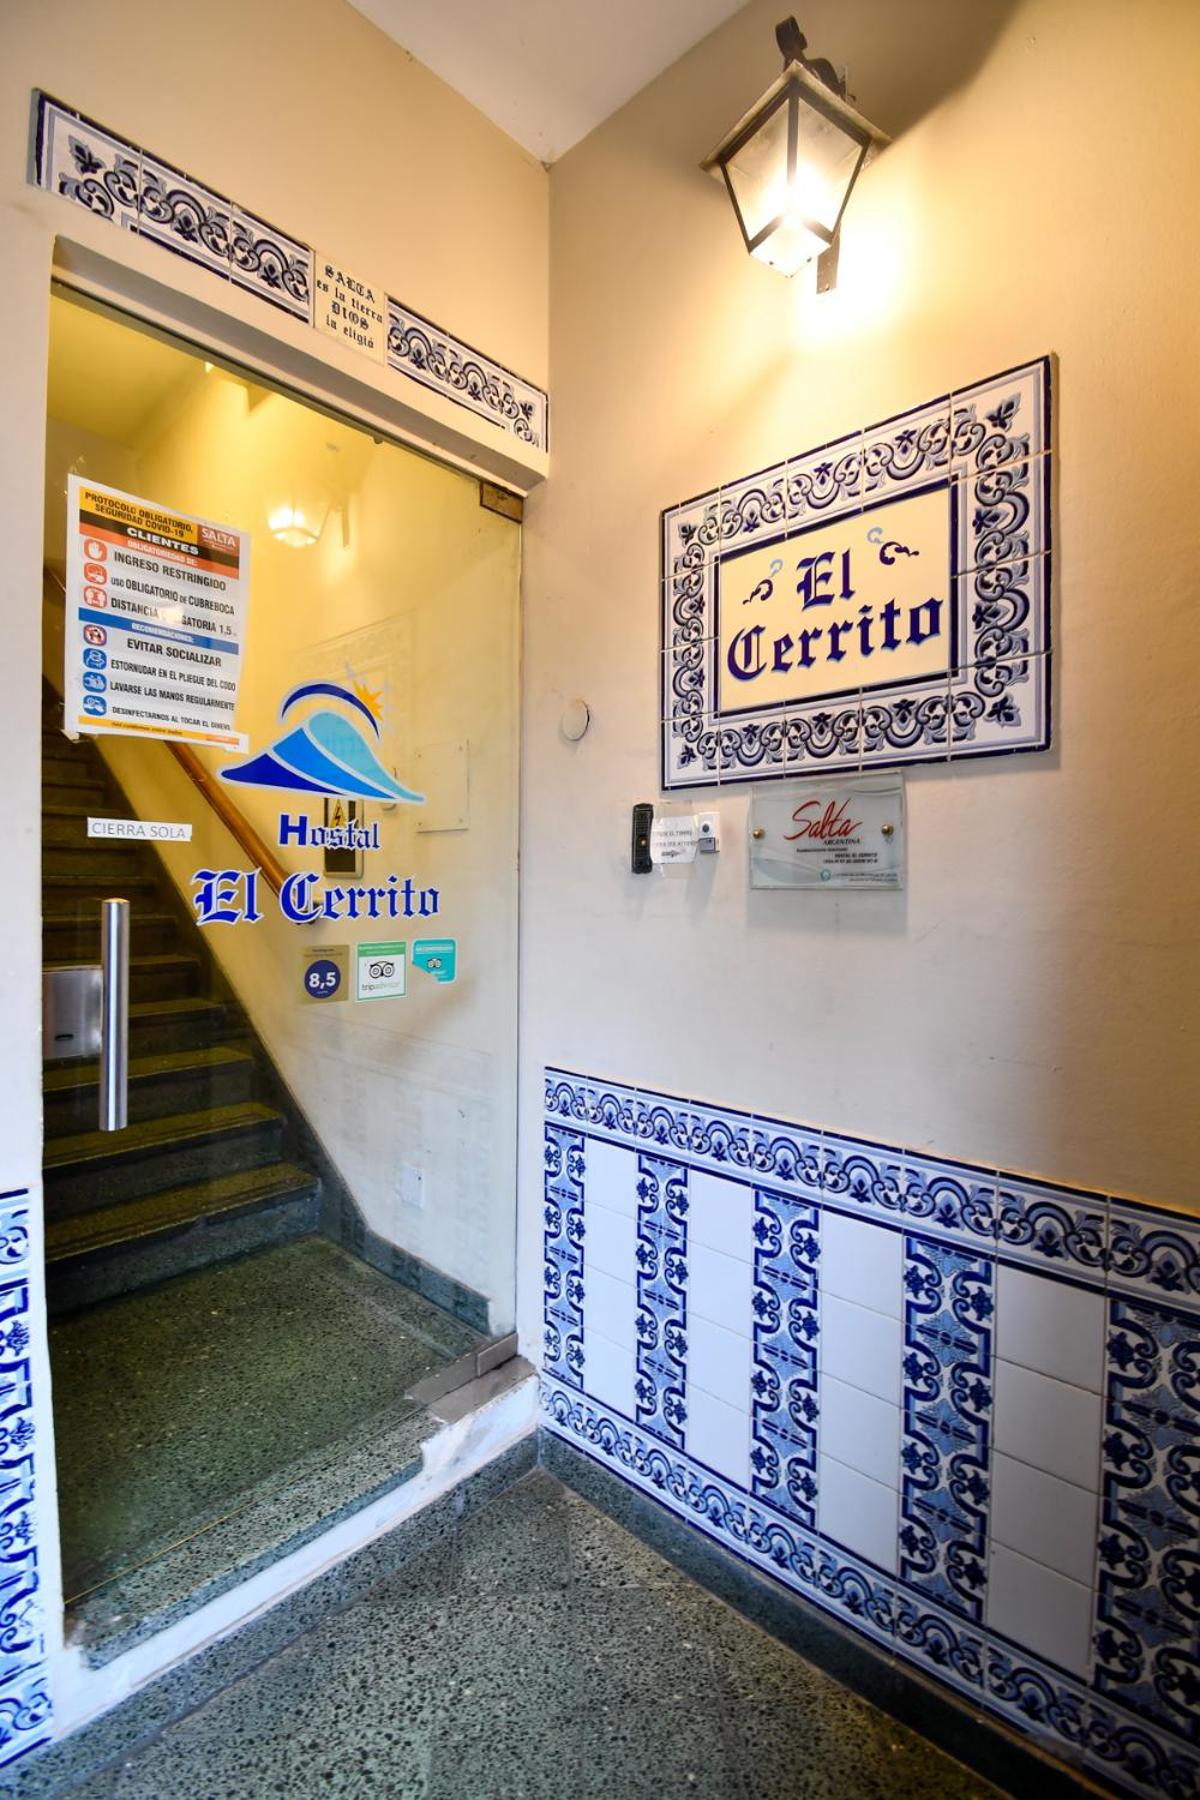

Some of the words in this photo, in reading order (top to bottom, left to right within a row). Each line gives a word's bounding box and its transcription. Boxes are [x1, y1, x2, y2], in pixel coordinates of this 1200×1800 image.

[95, 503, 143, 526] SEGURIDAD
[145, 519, 185, 539] COVID-19
[126, 527, 199, 556] CLIENTES
[201, 527, 236, 548] SALTA
[114, 551, 160, 573] INGRESO
[162, 565, 227, 591] RESTRINGIDO
[796, 548, 856, 612] El
[111, 598, 158, 619] DISTANCIA
[125, 579, 179, 602] OBLIGATORIO
[188, 595, 235, 616] CUBREBOCA
[127, 638, 163, 655] EVITAR
[166, 647, 222, 667] SOCIALIZAR
[726, 598, 944, 682] Cerrito
[111, 659, 157, 677] ESTORNUDAR
[158, 669, 168, 680] EN
[169, 671, 177, 681] EL
[178, 672, 205, 686] PLIEGUE
[206, 677, 218, 688] DEL
[110, 682, 142, 696] LAVARSE
[143, 687, 158, 698] LAS
[159, 689, 185, 702] MANOS
[91, 822, 146, 837] CIERRA
[149, 826, 186, 839] SOLA
[278, 813, 381, 850] Hostal
[784, 798, 863, 840] Salta
[192, 869, 264, 926] El
[279, 872, 440, 924] Cerrito
[309, 972, 336, 990] 8,5
